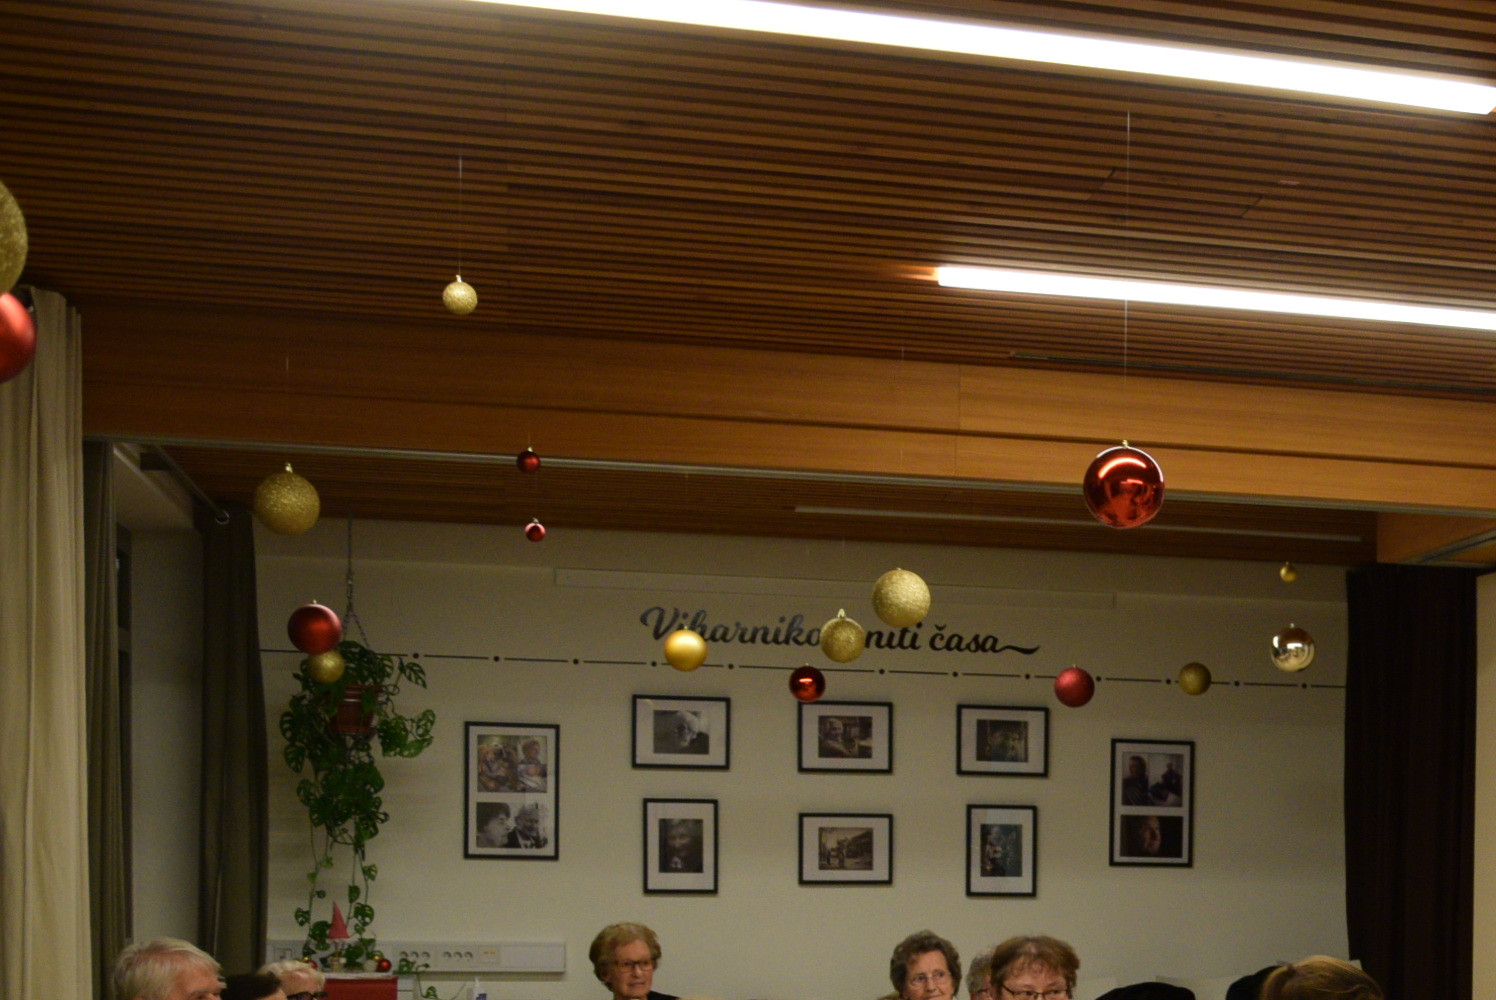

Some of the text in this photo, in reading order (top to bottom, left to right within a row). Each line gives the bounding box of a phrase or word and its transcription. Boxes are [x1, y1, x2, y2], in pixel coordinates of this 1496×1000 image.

[640, 606, 1040, 655] Viharniko niti časa
